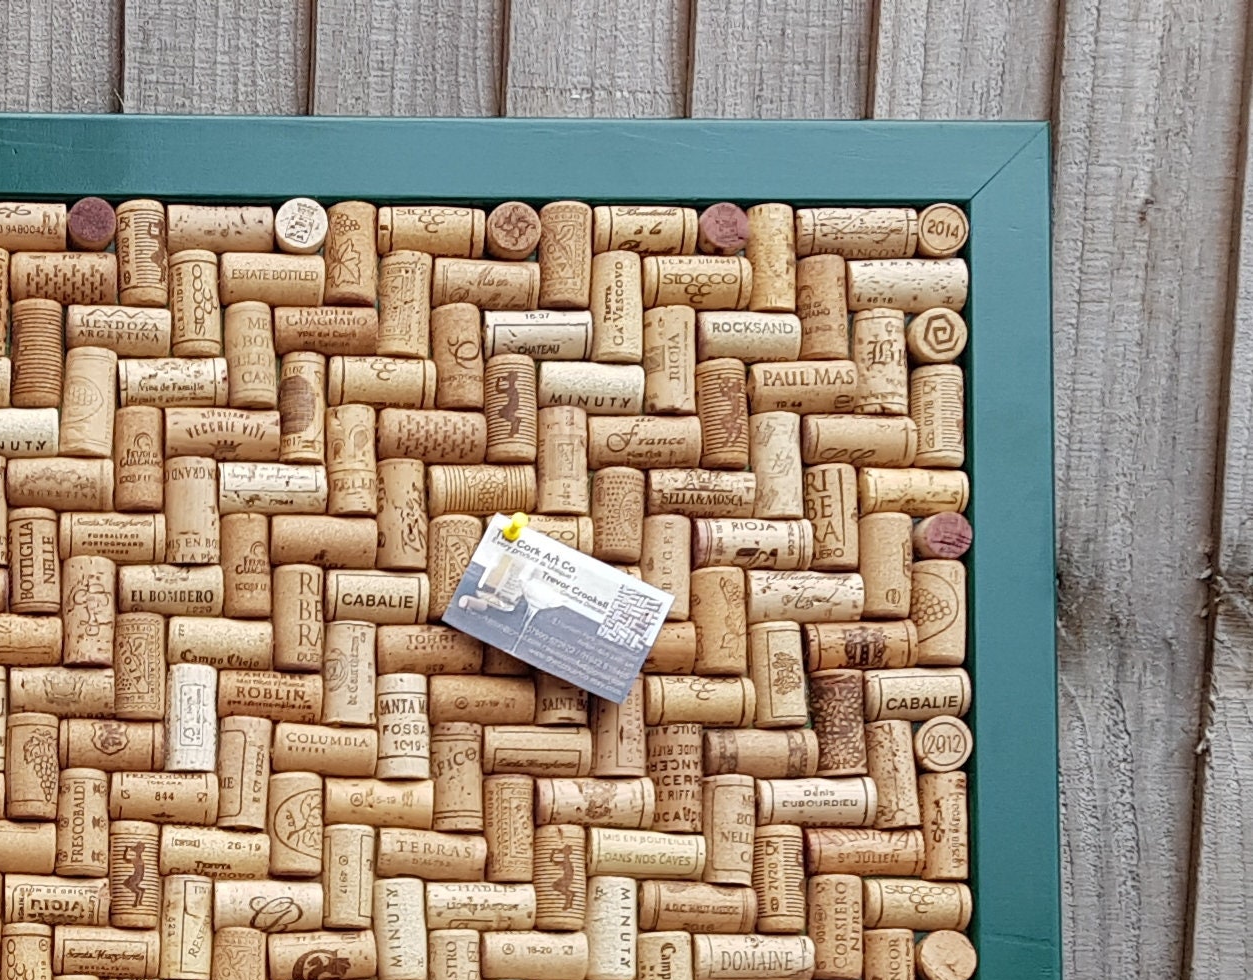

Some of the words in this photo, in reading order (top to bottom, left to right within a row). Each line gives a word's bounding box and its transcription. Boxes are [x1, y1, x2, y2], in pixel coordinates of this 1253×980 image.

[927, 218, 961, 239] 2014
[231, 268, 269, 282] ESTATE
[272, 268, 319, 282] BOTTLED
[712, 321, 795, 335] ROCKSAND
[517, 344, 560, 355] CHATEAU
[669, 332, 681, 382] RIOJA
[763, 369, 811, 387] PAUL
[814, 368, 855, 386] MAS
[549, 392, 633, 409] MINUTY
[606, 432, 686, 454] France
[659, 492, 745, 506] SELLA&MOSCA
[731, 520, 778, 533] RIOJA
[20, 520, 35, 603] BOTTIGLIA
[516, 540, 541, 557] Cork
[543, 552, 560, 565] Art
[561, 561, 576, 573] Co
[542, 571, 570, 589] Trevor
[131, 590, 146, 603] EL
[149, 590, 214, 603] BOMBERO
[341, 592, 415, 610] CABALIE
[180, 649, 225, 667] Campo
[228, 653, 261, 668] Viejo
[236, 687, 306, 703] ROBLIN
[886, 695, 959, 712] CABALIE
[286, 732, 369, 749] COLUMBIA
[926, 733, 963, 755] 2012
[71, 780, 87, 864] FRESCOBALDI
[395, 839, 473, 859] TERRAS
[602, 833, 622, 843] MIS
[625, 834, 640, 844] EN
[642, 835, 695, 847] BOUTEILLE
[602, 852, 630, 864] DANS
[632, 853, 654, 864] NOS
[657, 854, 692, 867] CAVES
[389, 887, 403, 968] MINUTY
[620, 887, 632, 969] MINUTY
[833, 881, 847, 969] CORSIERO
[720, 951, 794, 972] DOMAINE
